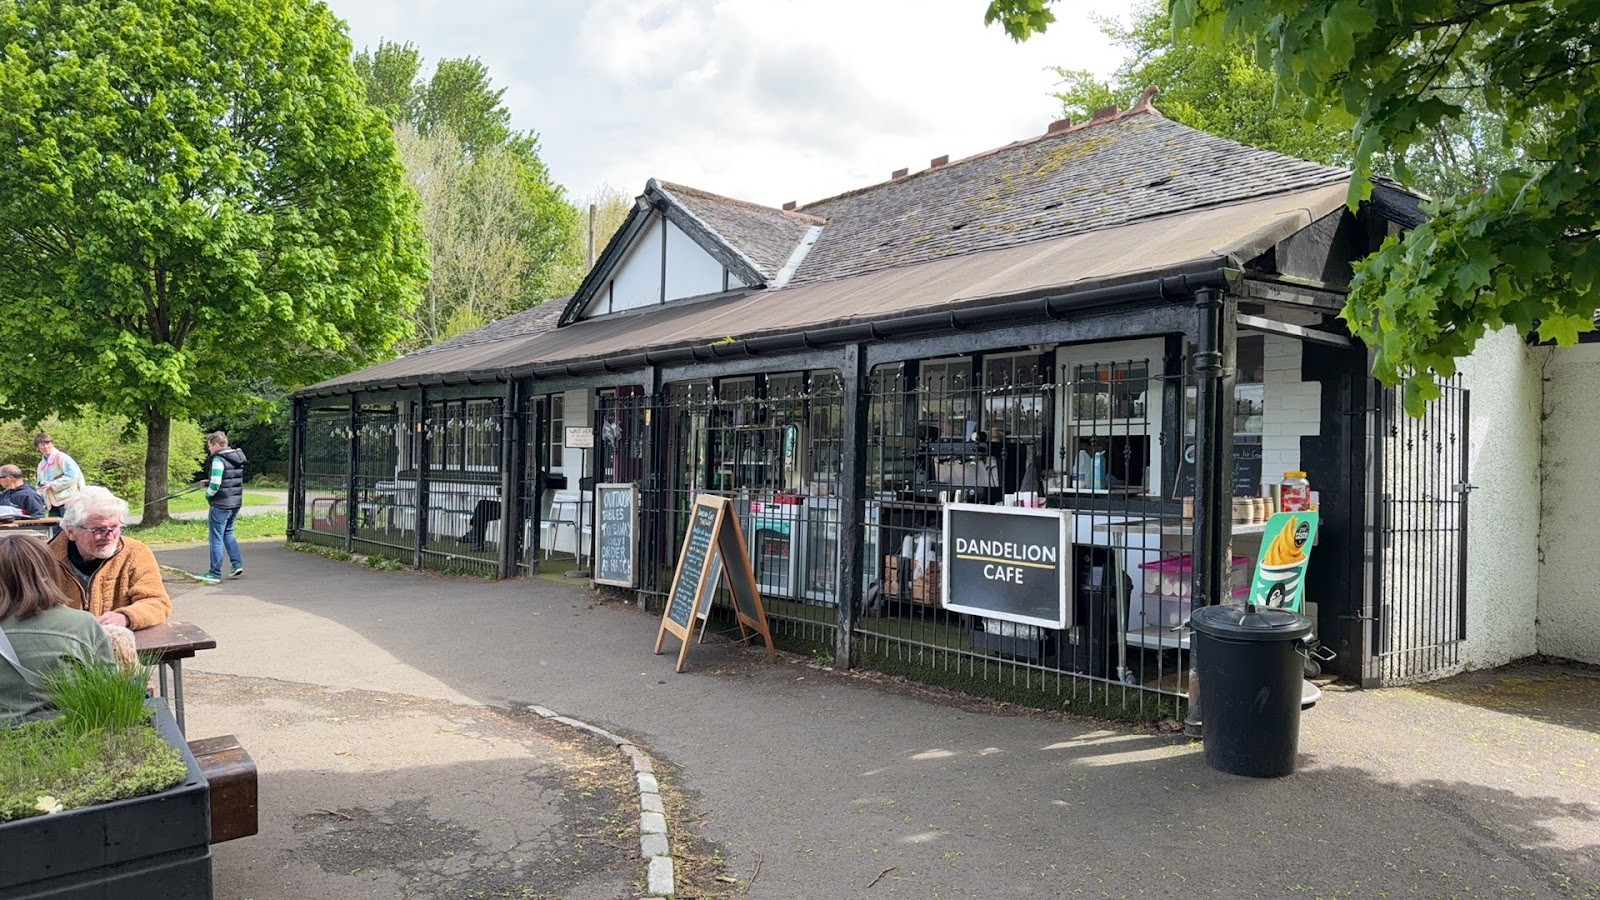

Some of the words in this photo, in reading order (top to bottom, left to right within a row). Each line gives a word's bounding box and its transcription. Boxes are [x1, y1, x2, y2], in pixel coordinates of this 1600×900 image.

[602, 546, 626, 559] ORDER
[956, 538, 1056, 562] DANDELION
[983, 564, 1024, 584] CAFE
